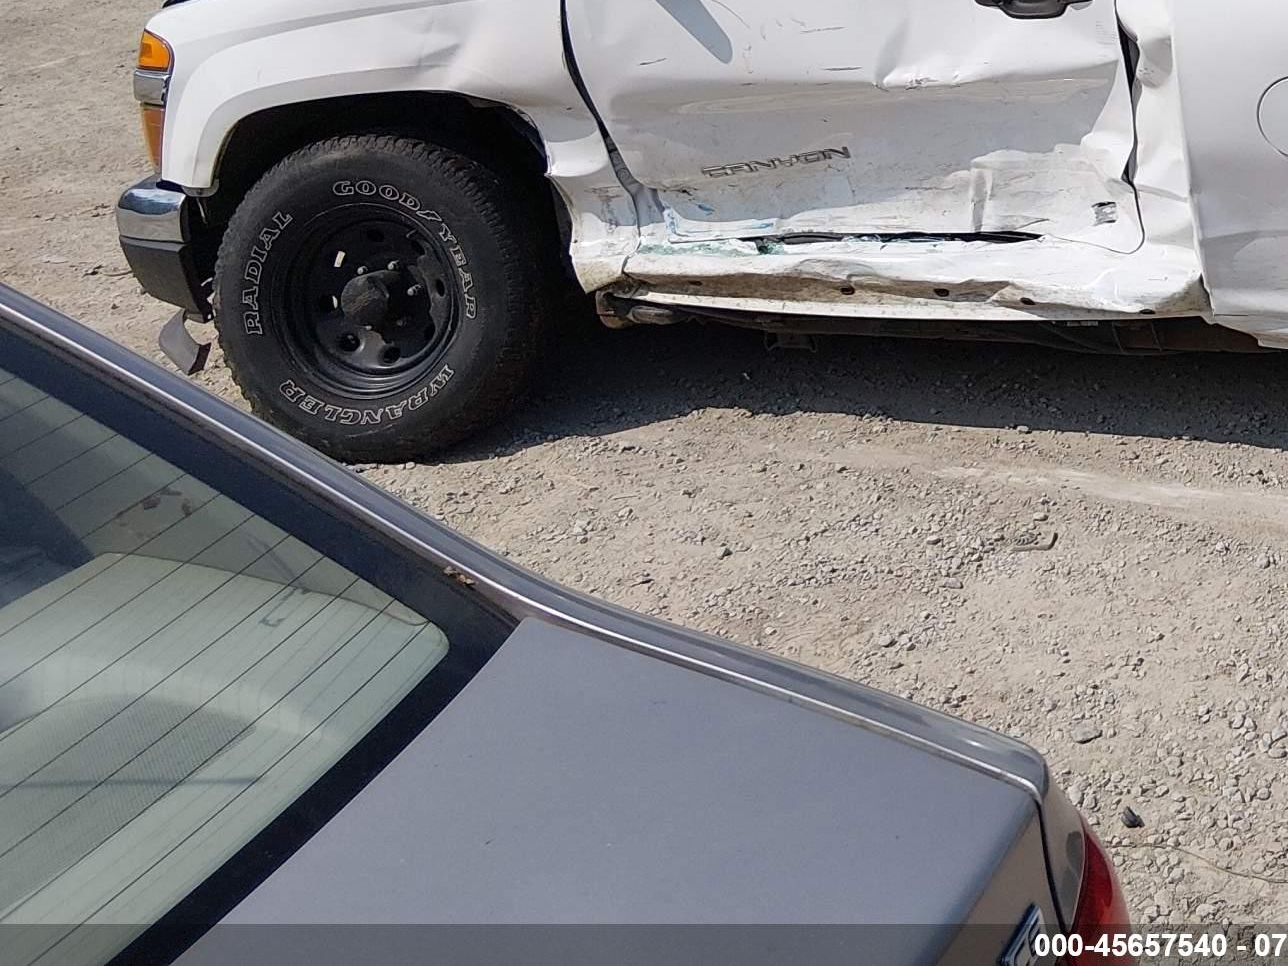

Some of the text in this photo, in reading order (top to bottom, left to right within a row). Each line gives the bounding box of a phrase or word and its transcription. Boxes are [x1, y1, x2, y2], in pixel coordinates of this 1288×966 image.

[701, 146, 851, 178] CANYON
[245, 210, 294, 336] RADIAL
[332, 180, 478, 319] GOODYEAR
[280, 364, 456, 425] WRANGLER
